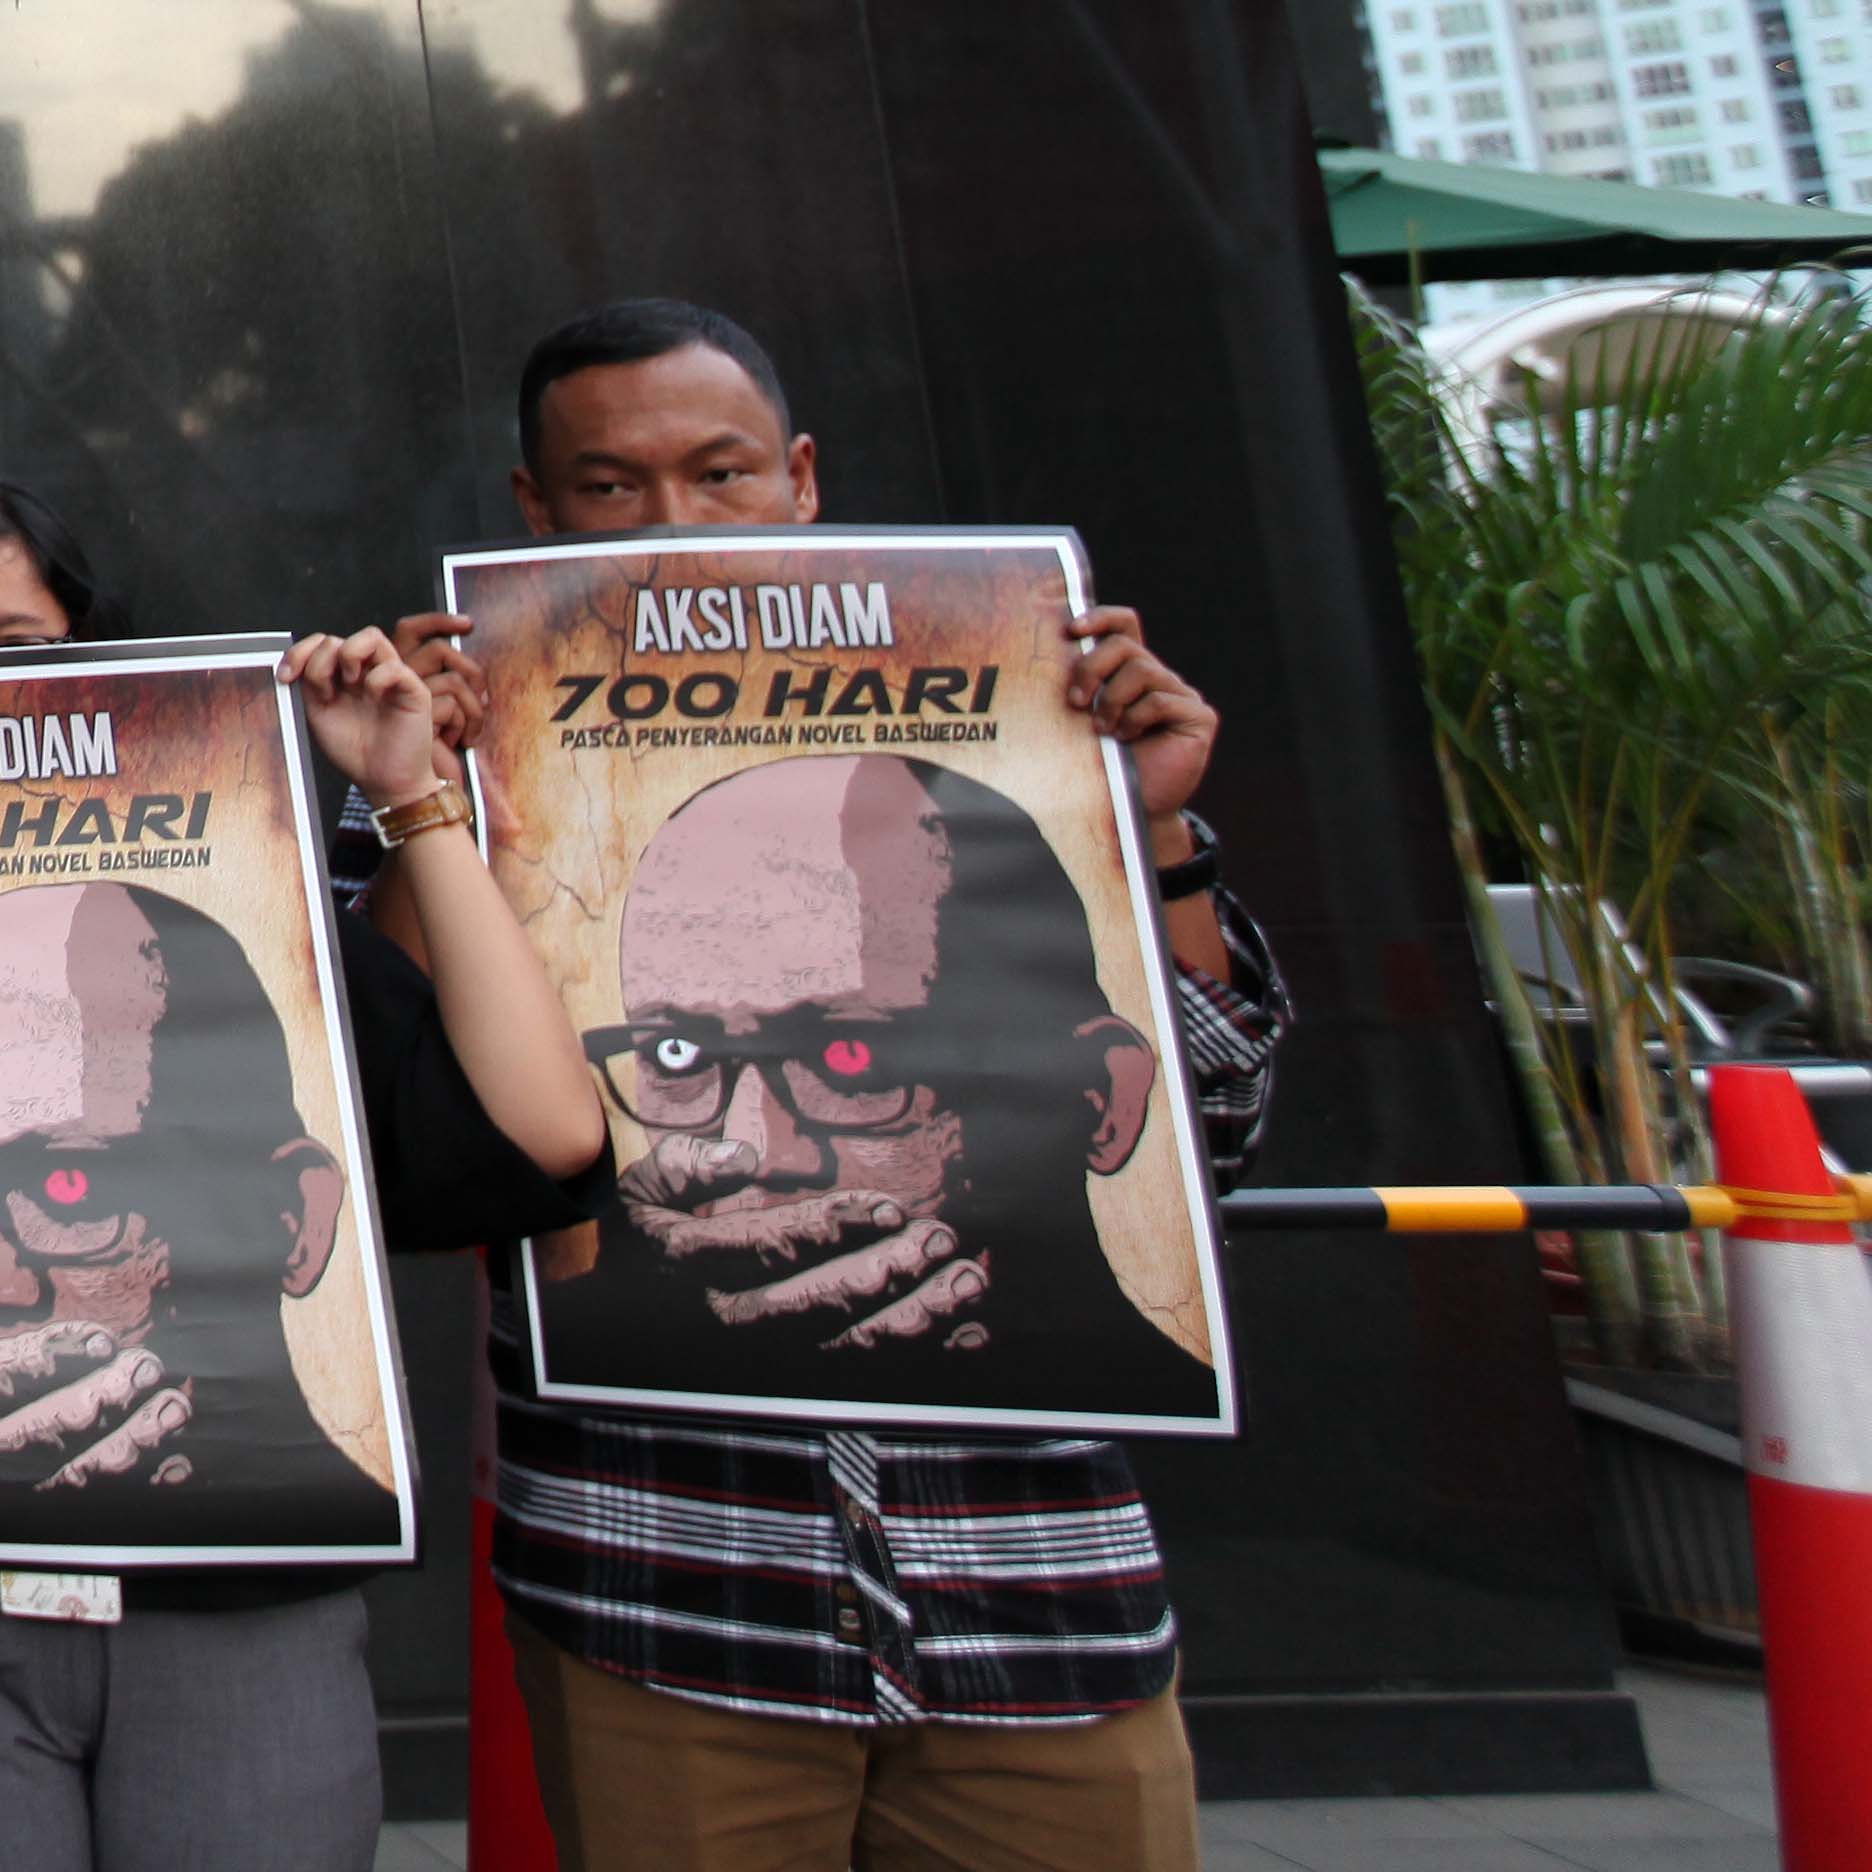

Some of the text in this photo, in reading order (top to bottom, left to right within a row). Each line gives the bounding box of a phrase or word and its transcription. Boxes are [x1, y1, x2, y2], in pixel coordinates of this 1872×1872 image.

[633, 581, 895, 655] AKSI DIAM
[549, 665, 1000, 722] 700 HARI
[560, 721, 998, 749] PASCA PENYERANGAN NOVEL BASWEDAN
[28, 853, 92, 876] NOVEL
[97, 846, 211, 872] BASWEDAN
